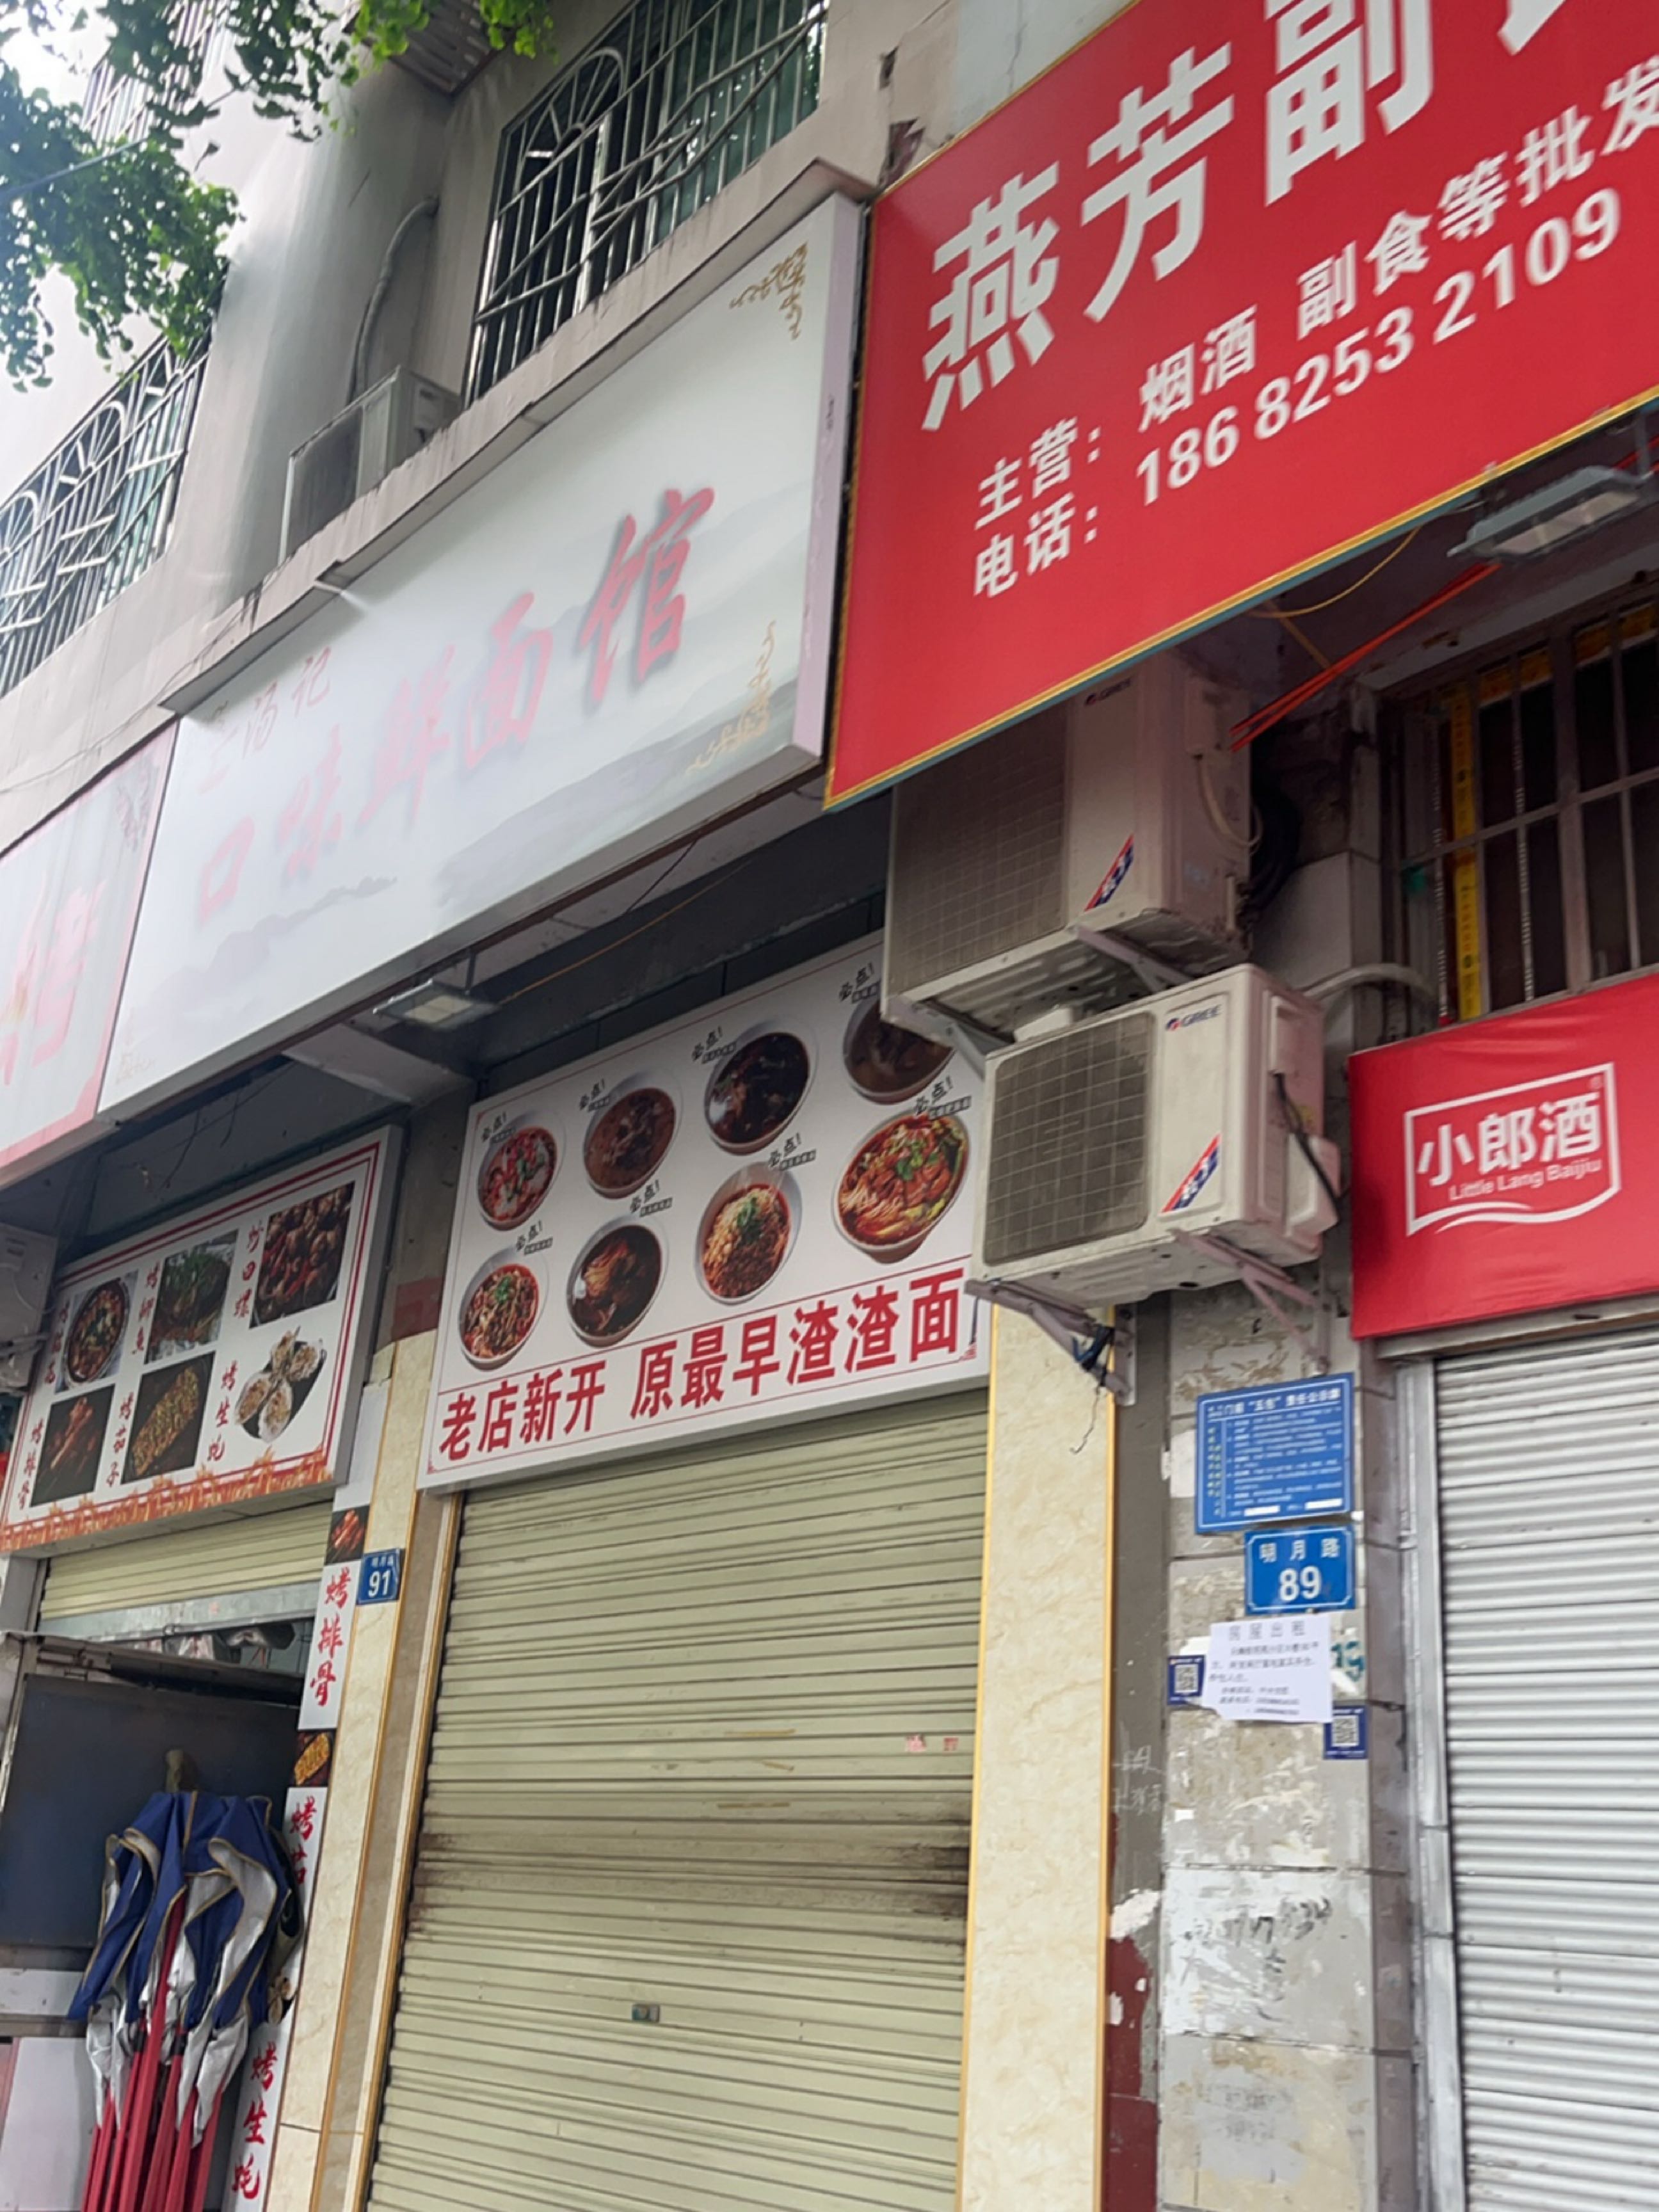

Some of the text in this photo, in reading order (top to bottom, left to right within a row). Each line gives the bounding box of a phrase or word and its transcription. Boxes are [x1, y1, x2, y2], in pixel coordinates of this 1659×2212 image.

[922, 0, 1567, 431] 燕芳副
[1138, 304, 1257, 432] 烟酒
[1297, 55, 1659, 341] 副食等批发
[1136, 405, 1239, 506] 186
[1254, 307, 1414, 440] 8253
[1433, 188, 1621, 344] 2109
[1417, 1092, 1601, 1187] 小郎酒
[1449, 1157, 1602, 1202] Little Lang Baijiu
[438, 1268, 965, 1462] 老店新开 原最早渣渣面
[368, 1570, 392, 1598] 91
[1259, 1536, 1340, 1564] 明月路
[1279, 1566, 1322, 1601] 89
[310, 1566, 352, 1707] 烤排骨
[232, 2040, 278, 2200] 烤生蚝
